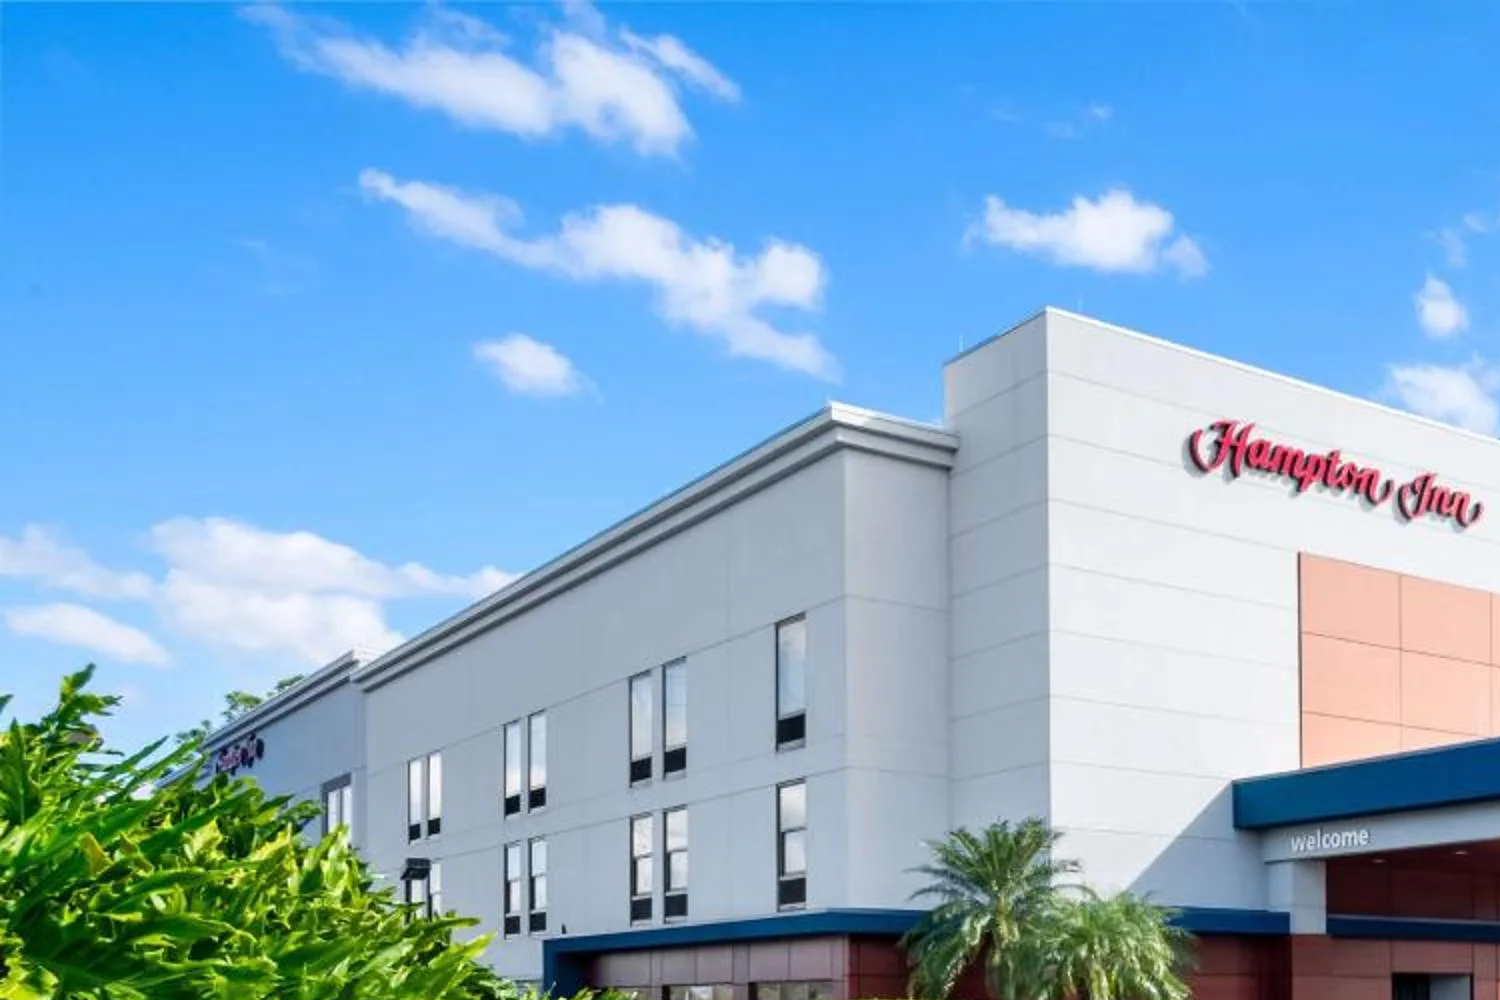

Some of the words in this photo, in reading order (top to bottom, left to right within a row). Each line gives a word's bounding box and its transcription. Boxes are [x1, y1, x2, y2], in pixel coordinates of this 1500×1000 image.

[1188, 419, 1394, 505] Hampton
[1397, 471, 1485, 528] Inn
[1291, 828, 1369, 851] welcome
